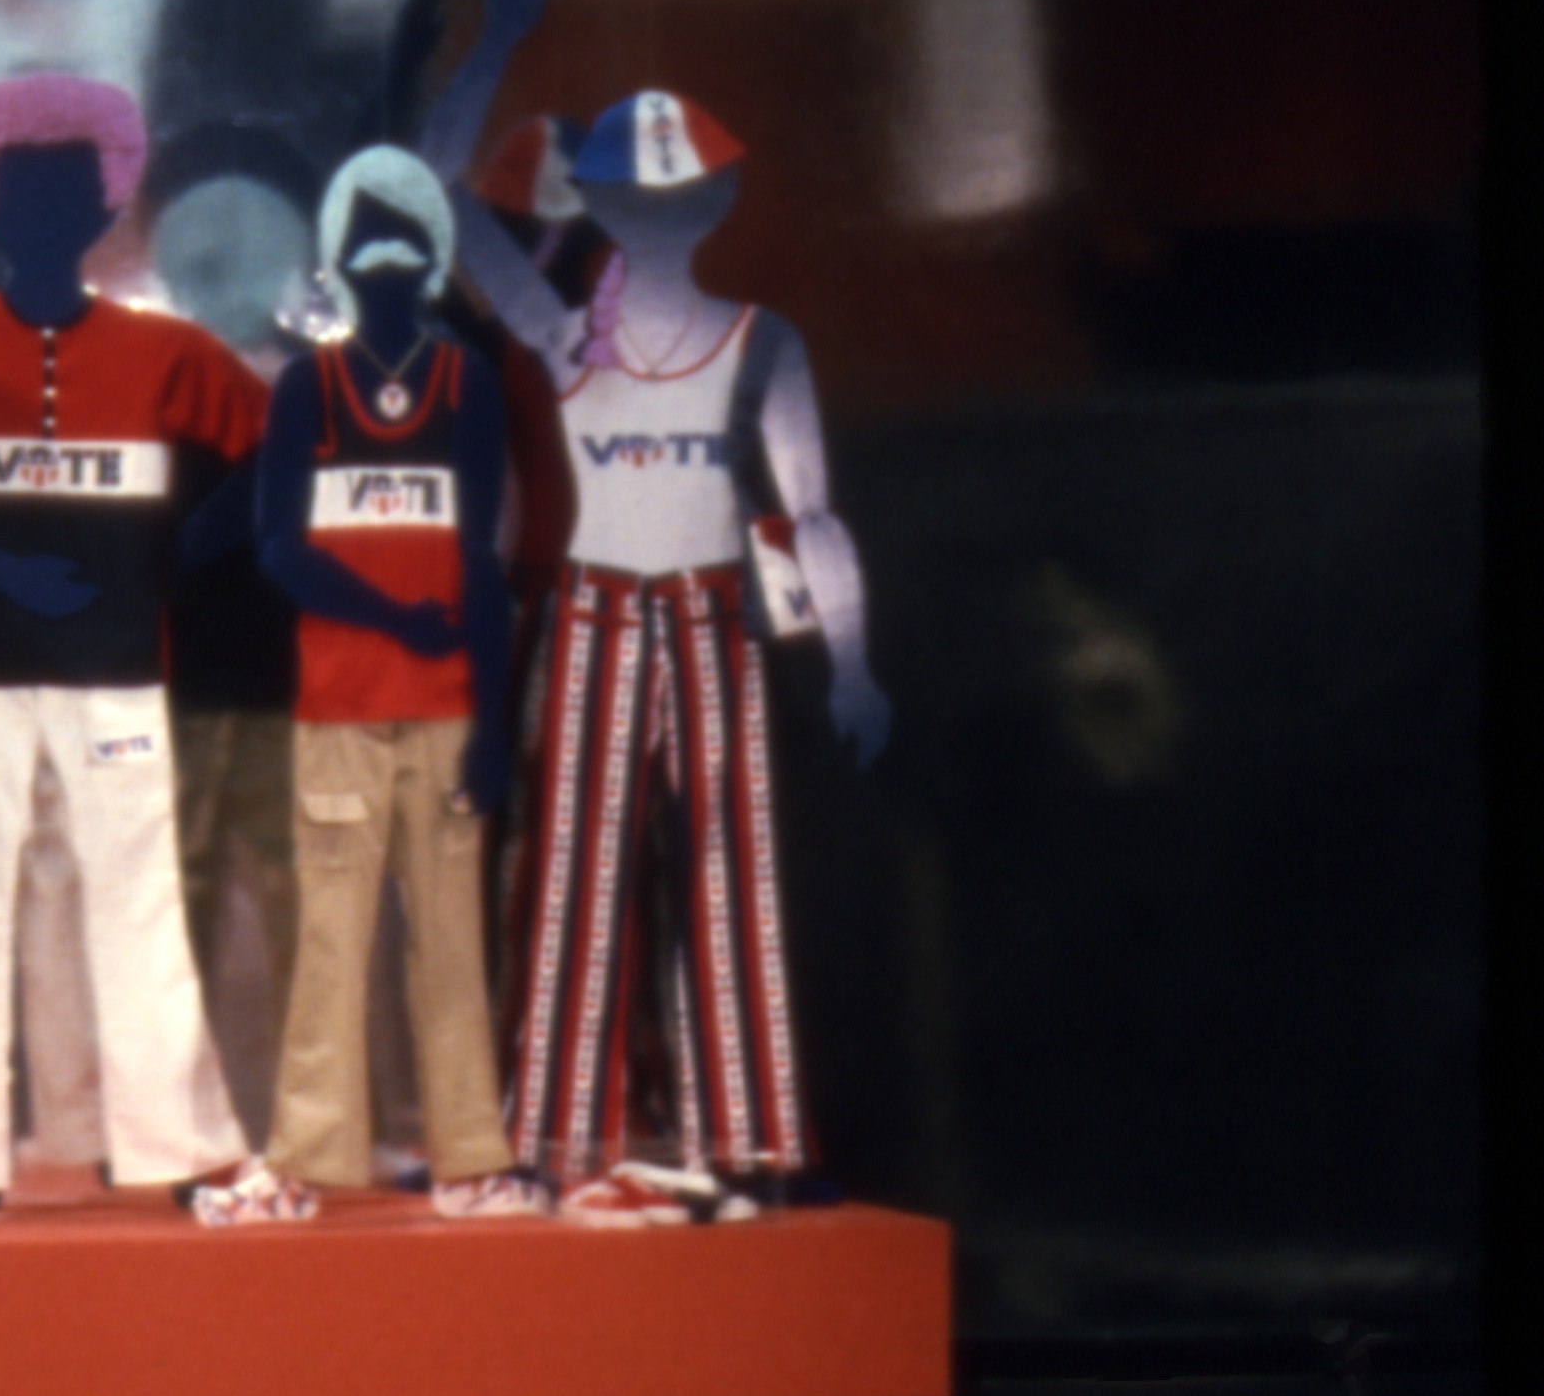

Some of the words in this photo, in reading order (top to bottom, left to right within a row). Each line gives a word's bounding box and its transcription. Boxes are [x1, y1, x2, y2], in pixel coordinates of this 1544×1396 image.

[580, 432, 735, 468] VOTE
[345, 473, 442, 516] VOTE
[96, 735, 153, 759] VOTE
